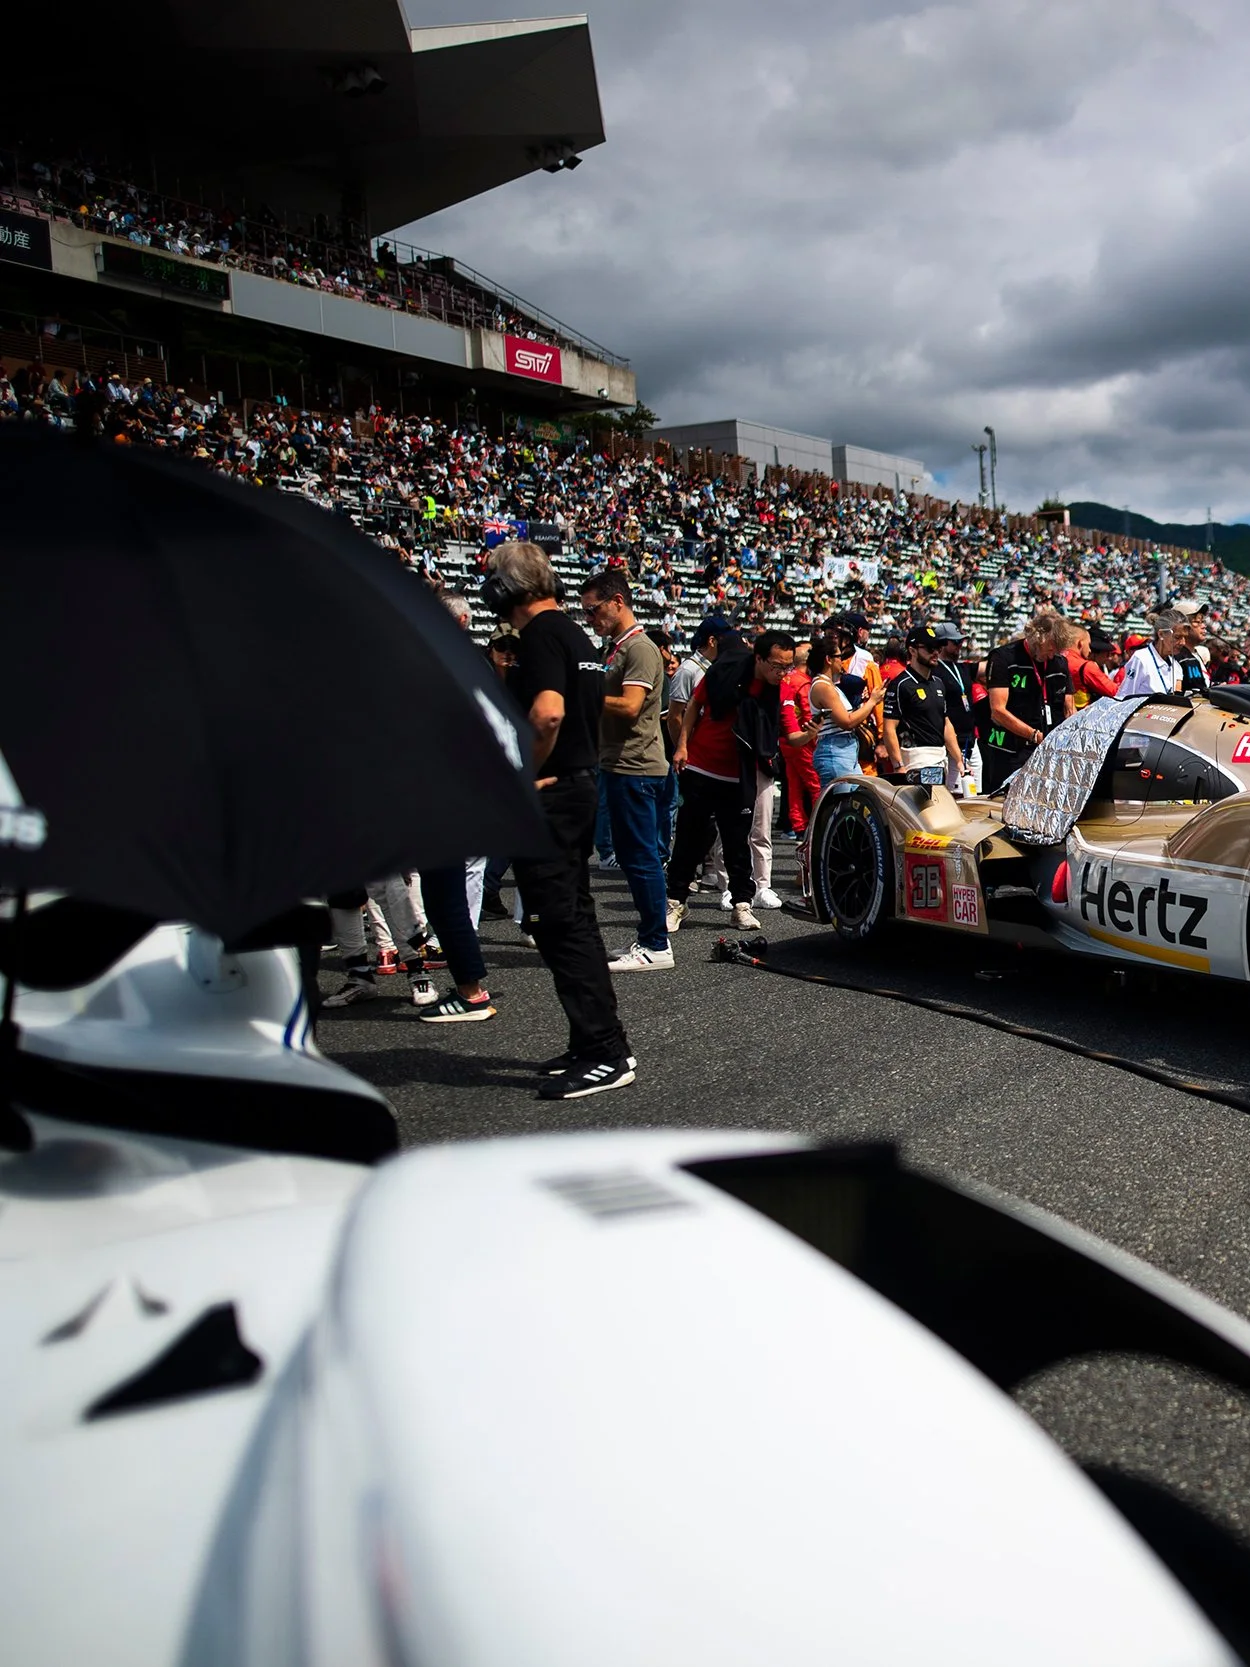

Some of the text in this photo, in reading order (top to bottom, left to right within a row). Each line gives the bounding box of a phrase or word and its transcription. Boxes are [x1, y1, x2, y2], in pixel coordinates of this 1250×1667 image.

[1011, 674, 1027, 689] 31
[912, 865, 940, 907] 38
[953, 887, 976, 902] HYPER
[954, 900, 977, 923] CAR
[1081, 861, 1208, 950] Hertz
